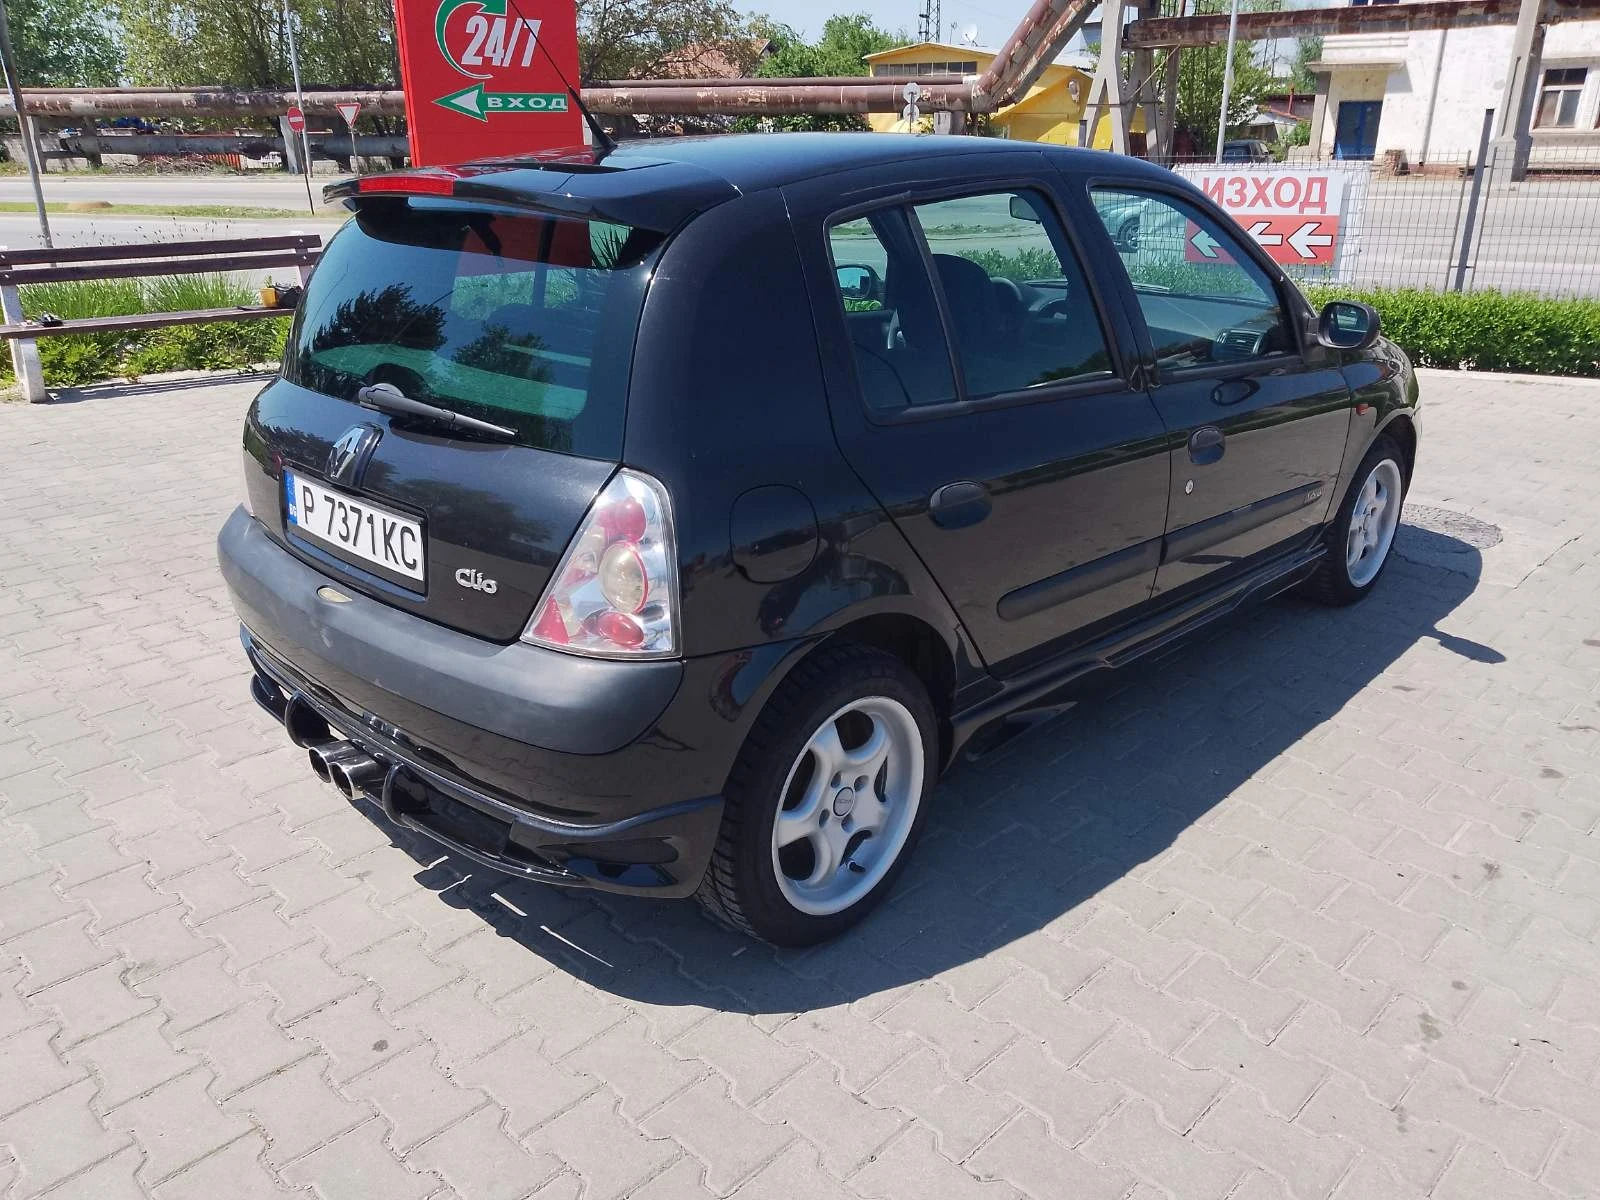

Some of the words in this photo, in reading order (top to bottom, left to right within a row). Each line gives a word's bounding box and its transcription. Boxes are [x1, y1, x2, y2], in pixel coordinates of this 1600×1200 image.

[461, 15, 542, 68] 24/7
[487, 96, 568, 110] ВХОД
[1202, 176, 1329, 215] ИЗХОД
[455, 568, 498, 594] Clio
